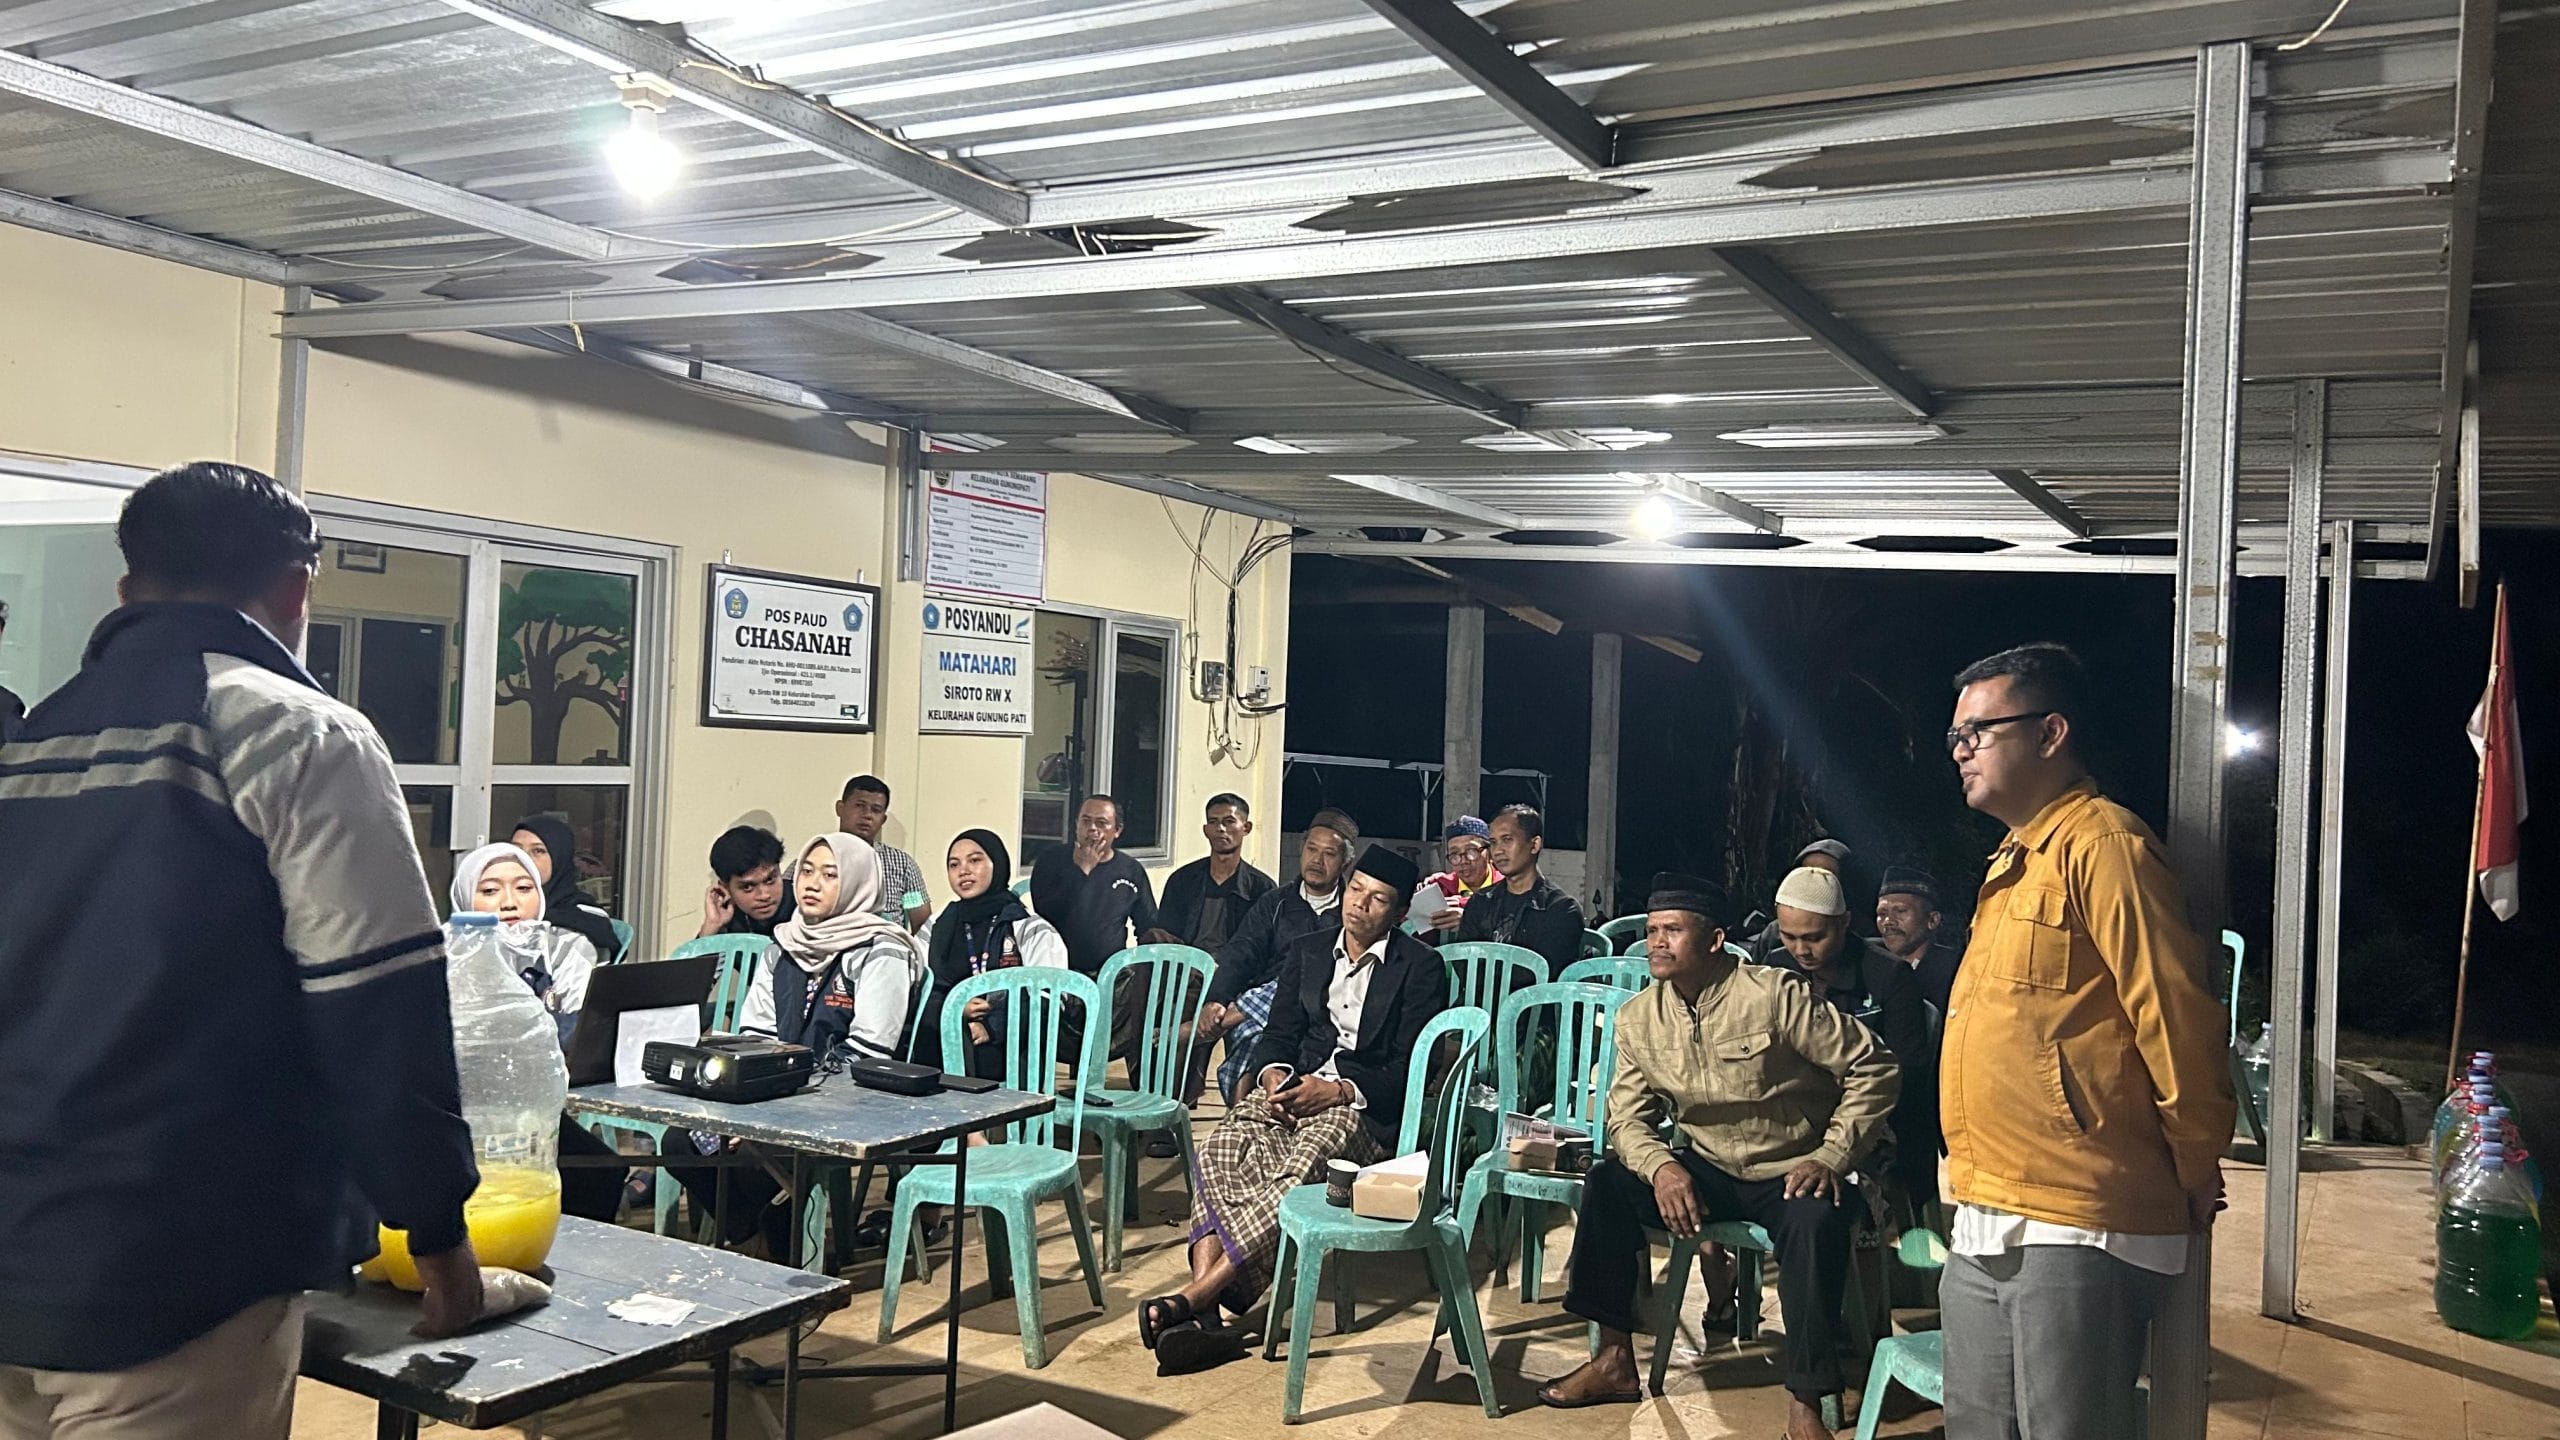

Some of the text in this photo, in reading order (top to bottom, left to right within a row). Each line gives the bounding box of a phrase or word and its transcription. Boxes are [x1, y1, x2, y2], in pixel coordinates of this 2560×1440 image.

[765, 608, 828, 628] POS PAUD
[945, 607, 1011, 635] POSYANDU
[735, 625, 852, 657] CHASANAH
[939, 651, 1017, 676] MATAHARI
[944, 685, 1012, 702] SIROTO RW X
[928, 709, 1027, 724] KELURAHAN GUNUNG PATI
